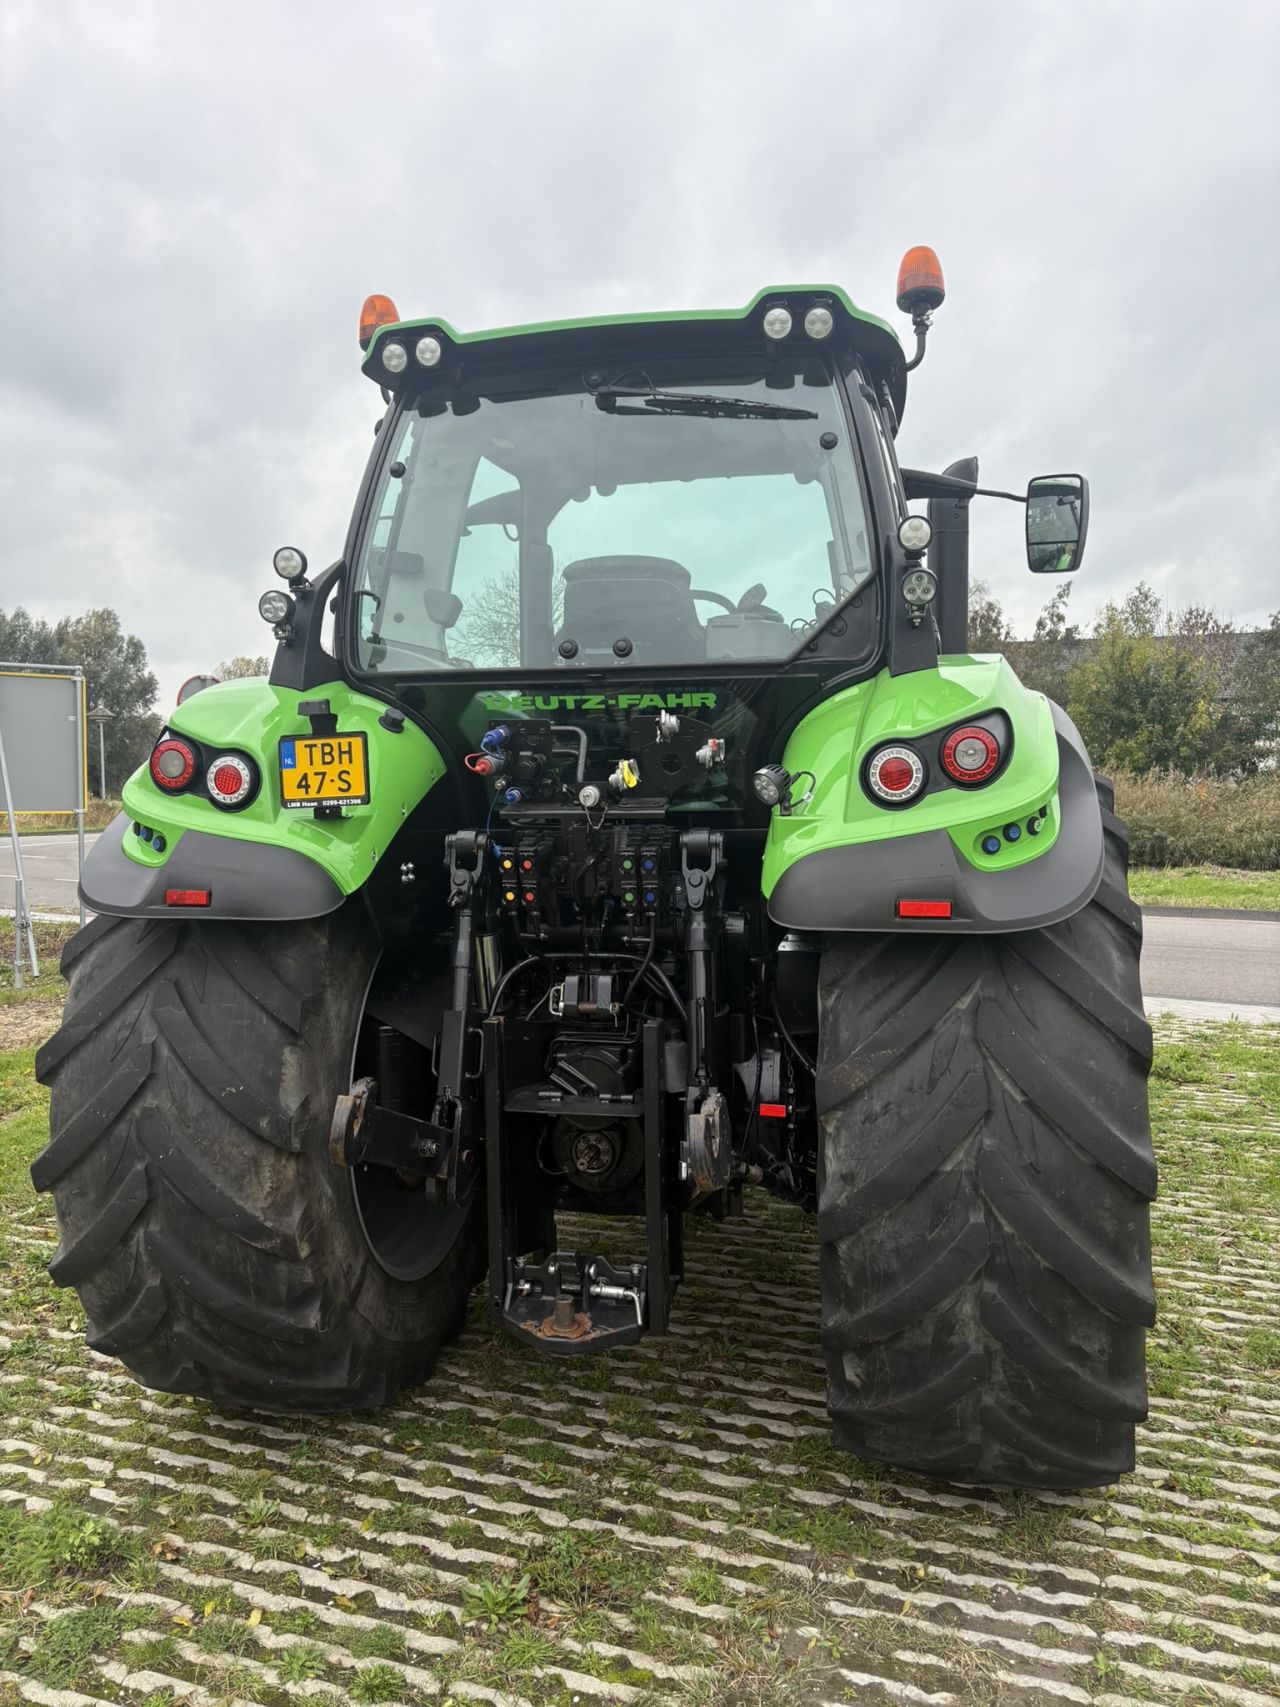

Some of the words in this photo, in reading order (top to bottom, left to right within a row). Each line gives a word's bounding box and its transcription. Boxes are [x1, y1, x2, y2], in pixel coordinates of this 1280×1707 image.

[485, 691, 717, 710] DEUTZ-FAHR
[304, 742, 352, 766] TBH
[296, 770, 352, 794] 47-S
